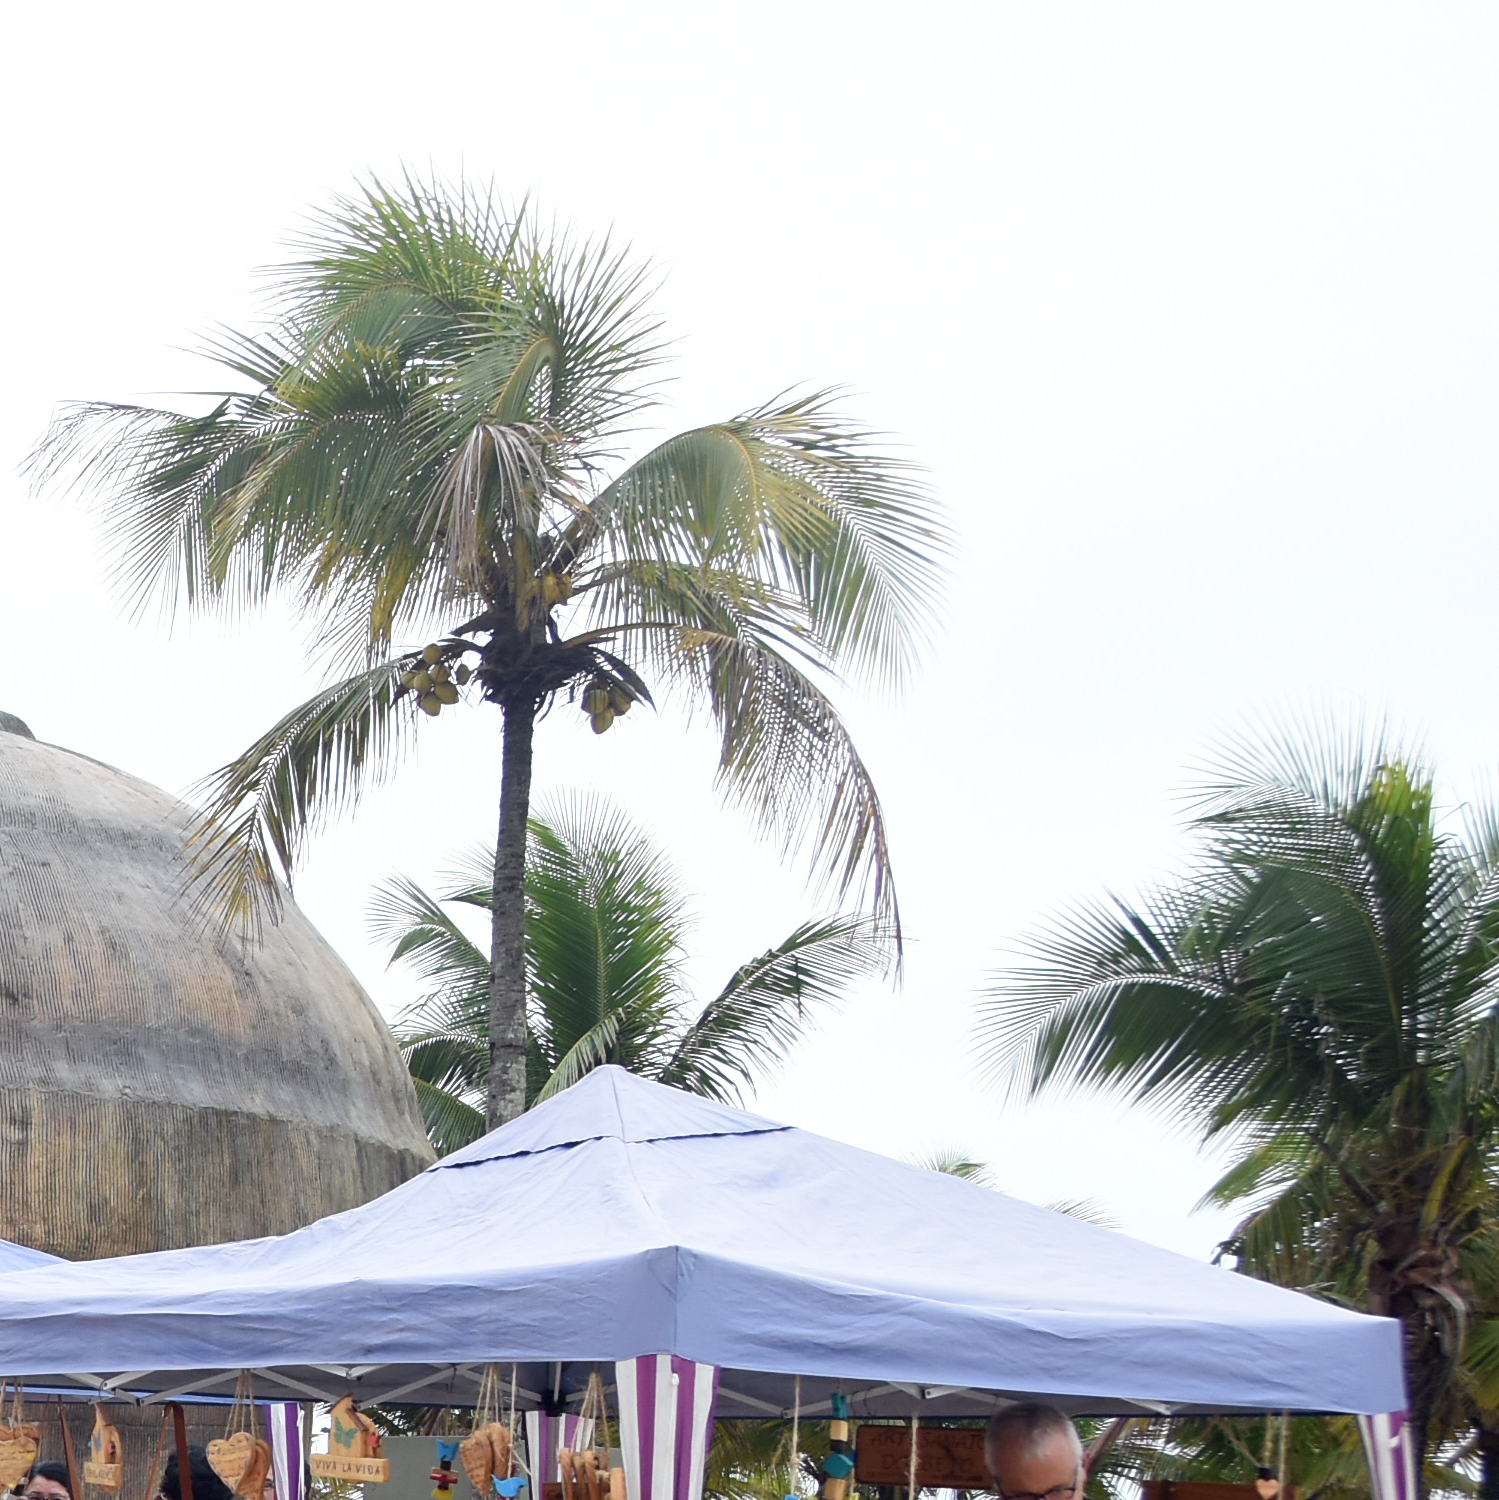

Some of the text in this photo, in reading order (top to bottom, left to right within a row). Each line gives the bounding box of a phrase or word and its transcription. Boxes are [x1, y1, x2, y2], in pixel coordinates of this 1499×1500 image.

[315, 1461, 382, 1476] VIVA LA VIDA
